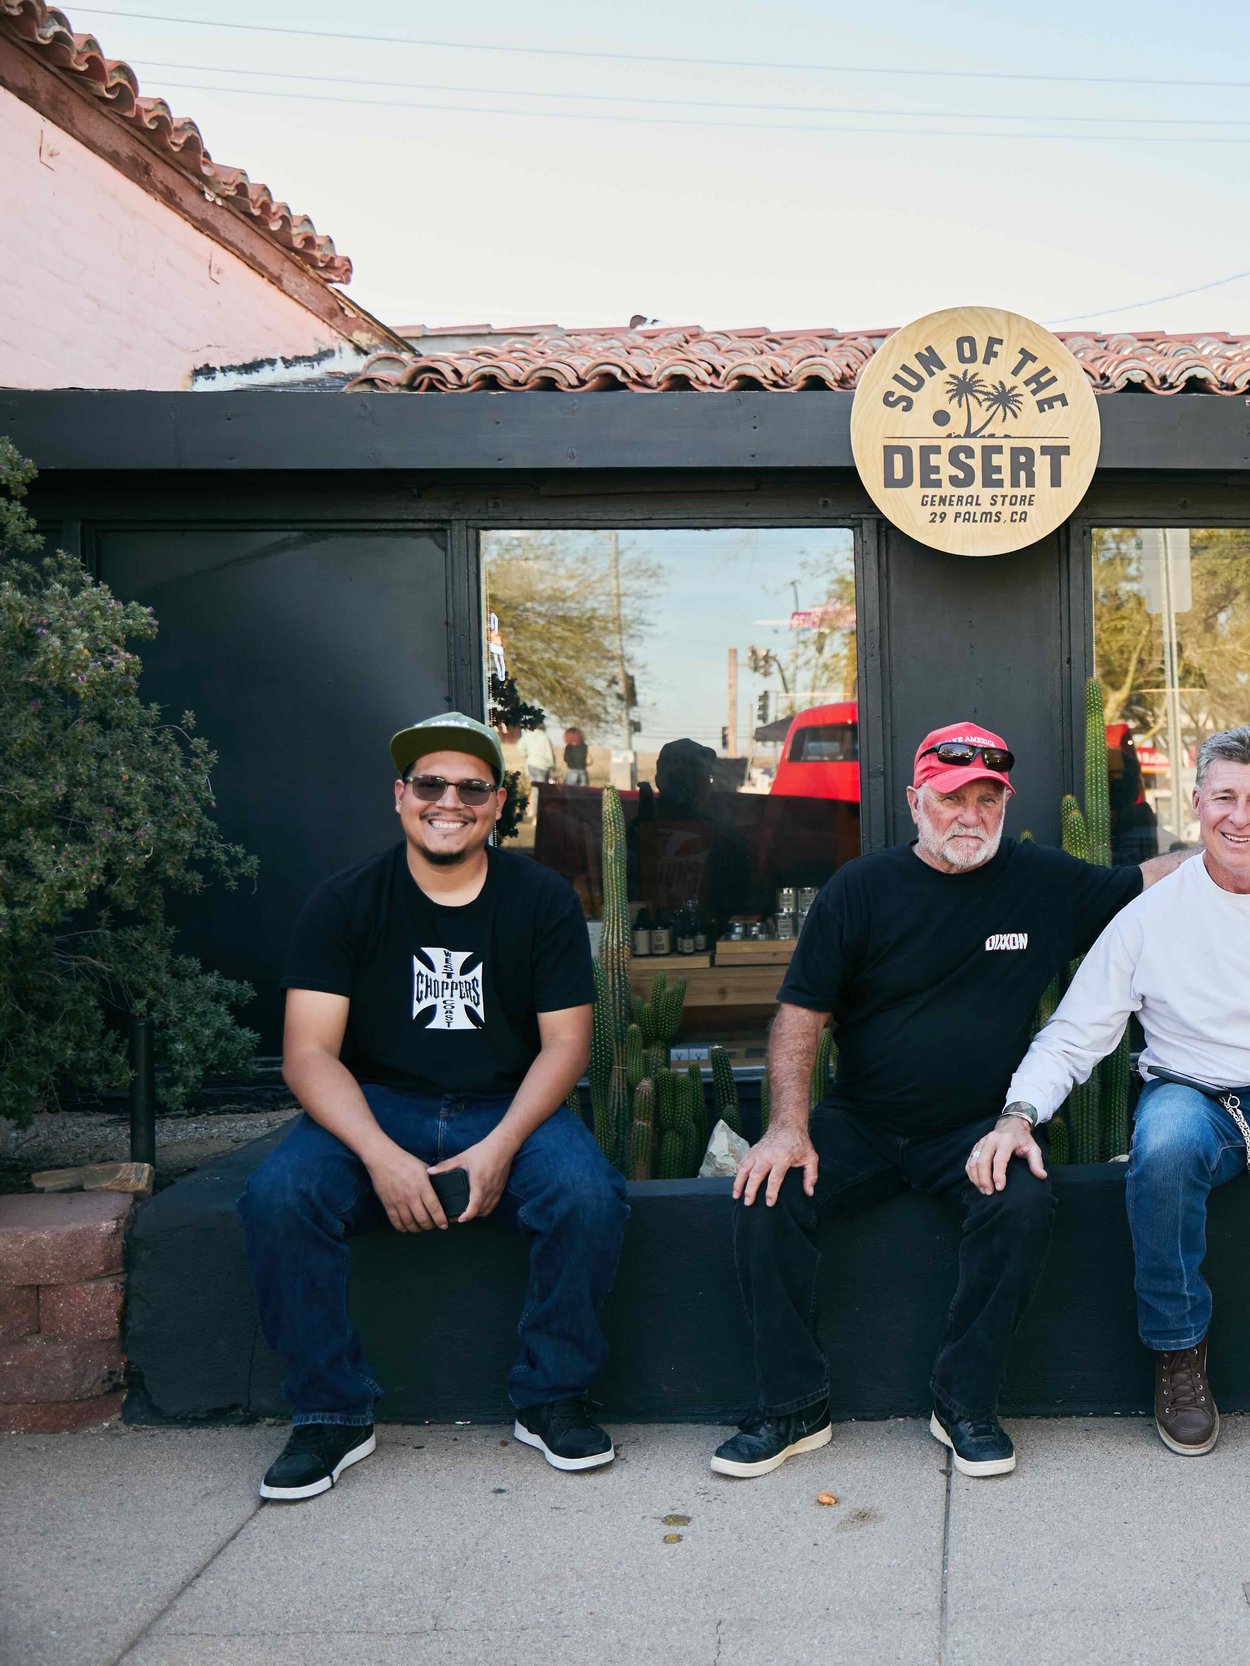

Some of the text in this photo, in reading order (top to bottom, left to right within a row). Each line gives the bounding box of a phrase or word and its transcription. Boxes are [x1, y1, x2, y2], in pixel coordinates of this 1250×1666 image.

[883, 335, 1069, 414] SUN OF THE
[882, 444, 1071, 489] DESERT
[920, 494, 1035, 507] GENERAL STORE
[928, 511, 947, 523] 29
[442, 949, 455, 980] WEST
[415, 970, 481, 1008] CHOPPERS
[442, 999, 456, 1029] COAST
